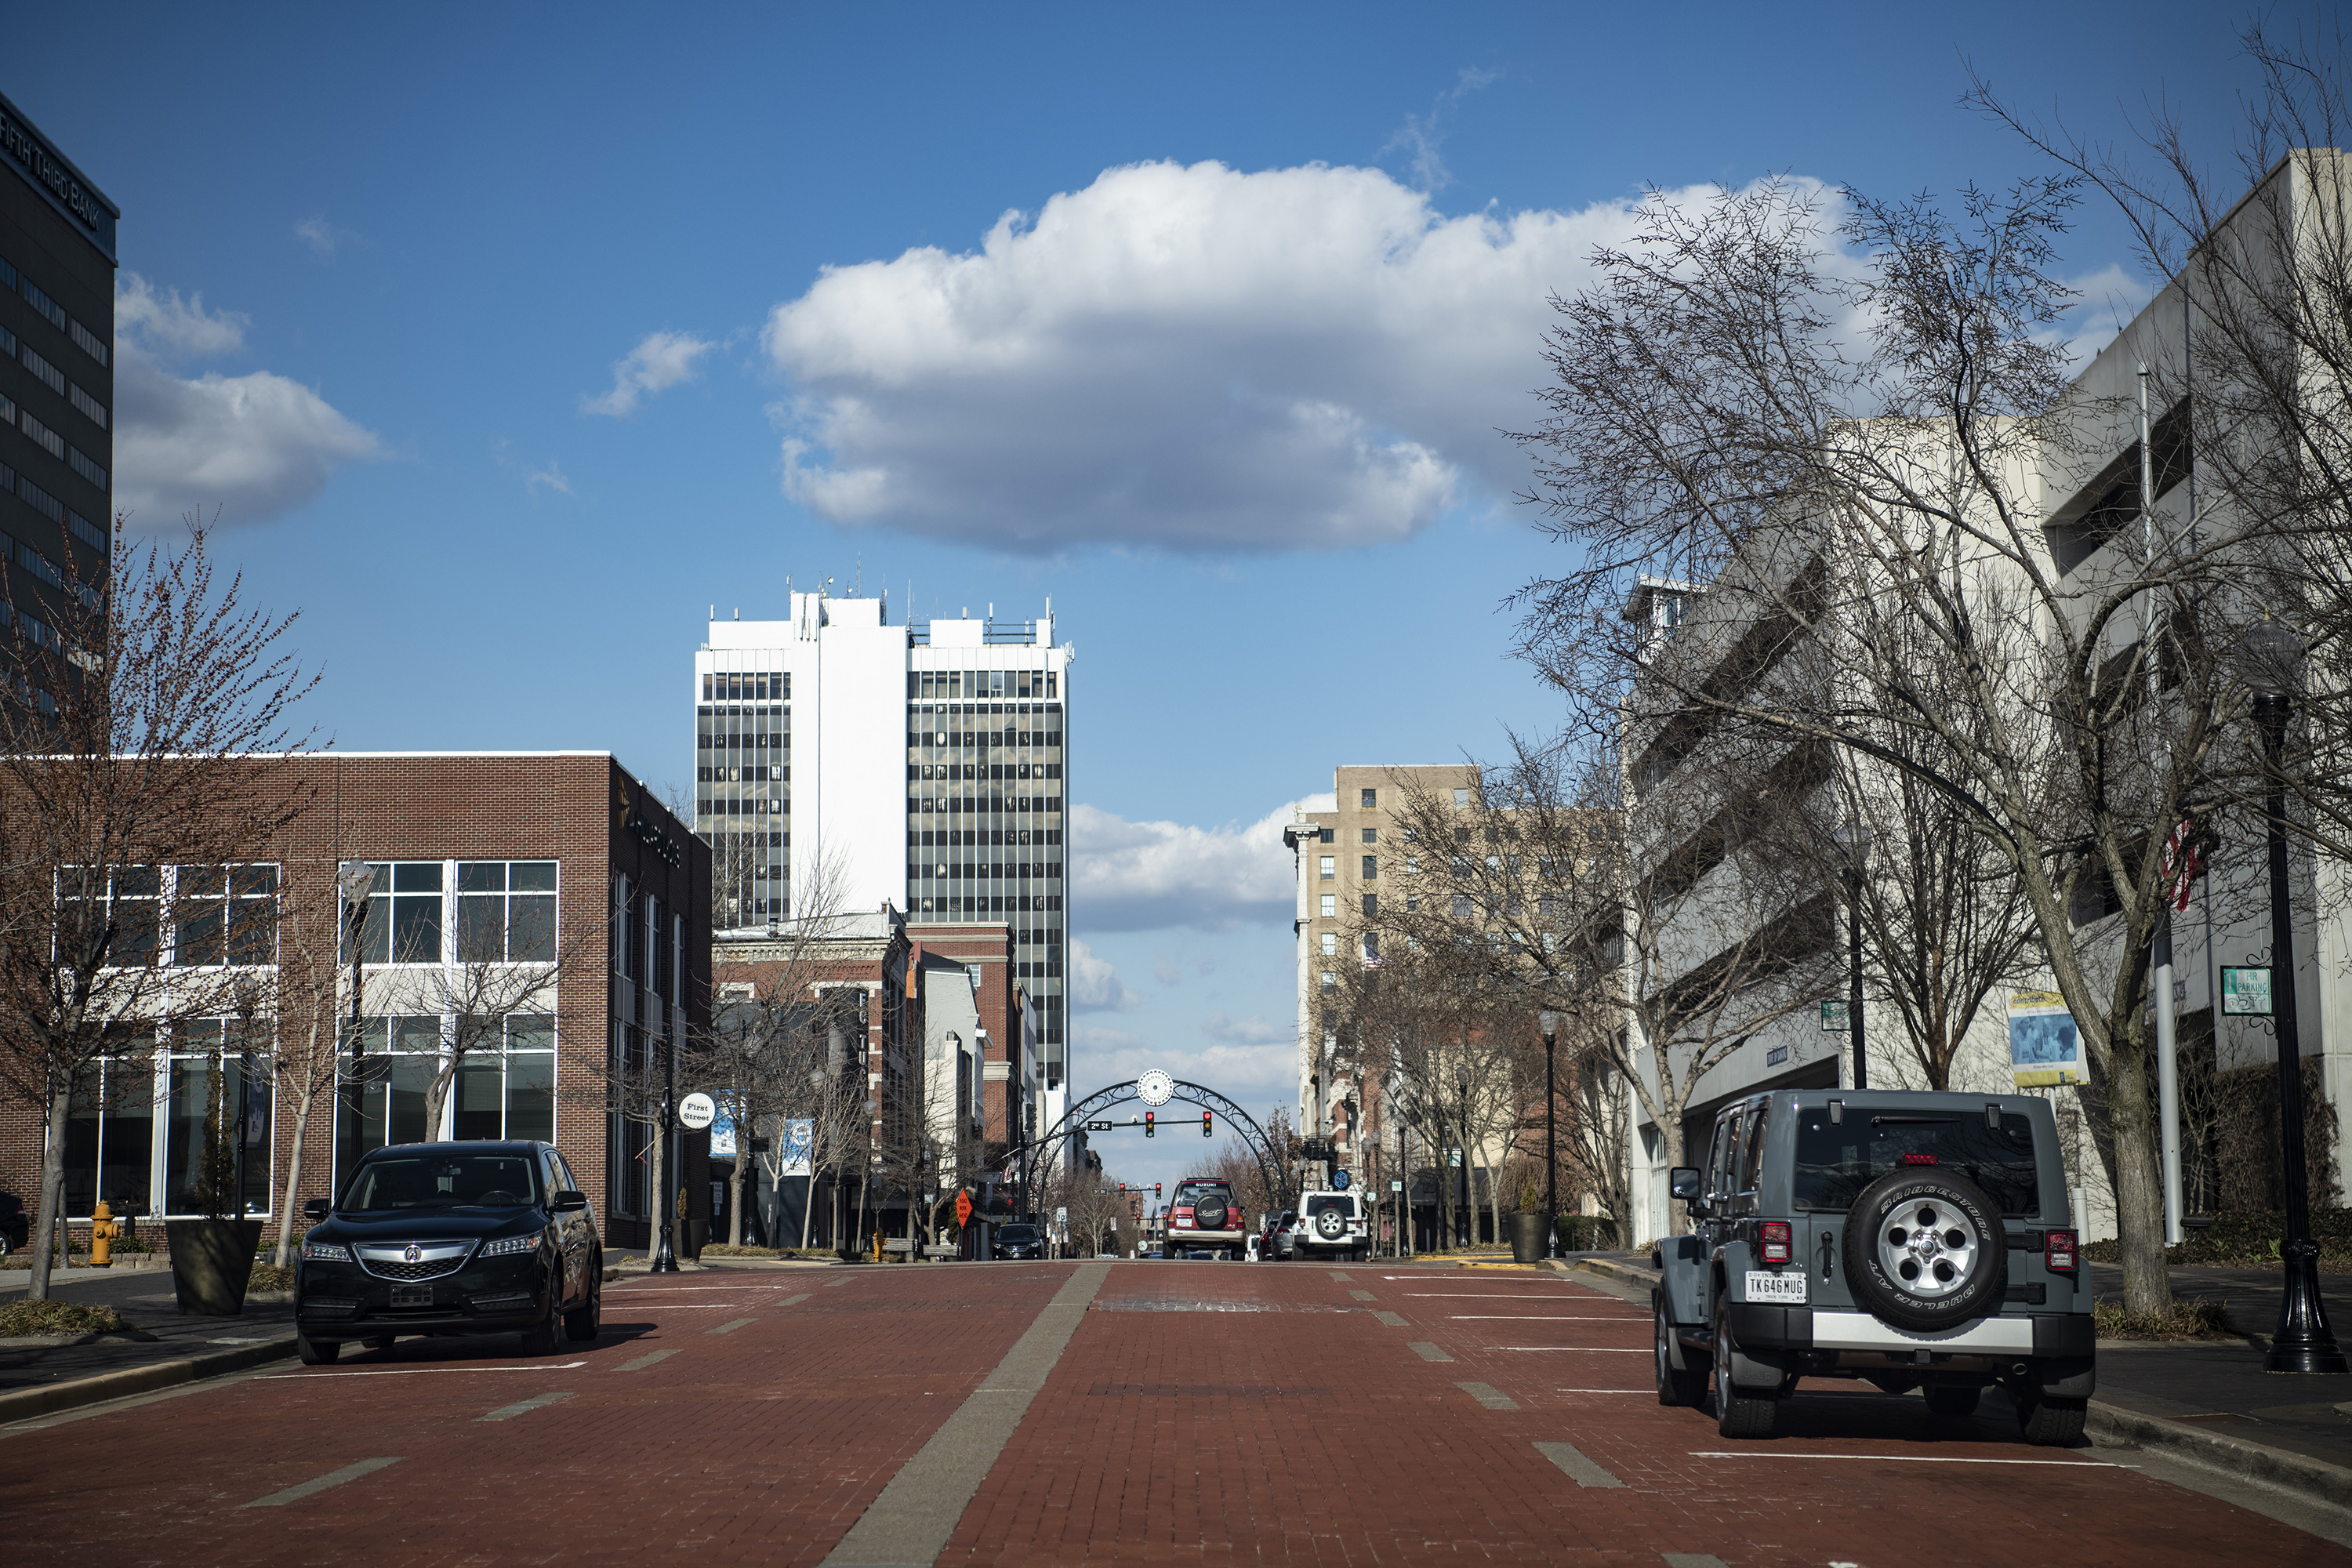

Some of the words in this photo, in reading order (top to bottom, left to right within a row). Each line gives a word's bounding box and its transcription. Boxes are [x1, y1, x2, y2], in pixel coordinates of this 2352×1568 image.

[0, 114, 31, 166] FIFTH
[35, 147, 68, 199] THIRD
[71, 183, 99, 230] BANK
[2246, 972, 2258, 981] HR
[2238, 982, 2267, 992] PARKING
[1142, 1076, 1167, 1087] Evansville
[1157, 1089, 1168, 1100] City
[687, 1103, 708, 1112] First
[684, 1112, 710, 1121] Street
[1198, 1209, 1223, 1218] Sport
[1881, 1185, 1991, 1241] BRIDGESTONE
[1867, 1259, 1893, 1290] A/T
[1894, 1284, 1976, 1310] DUELER
